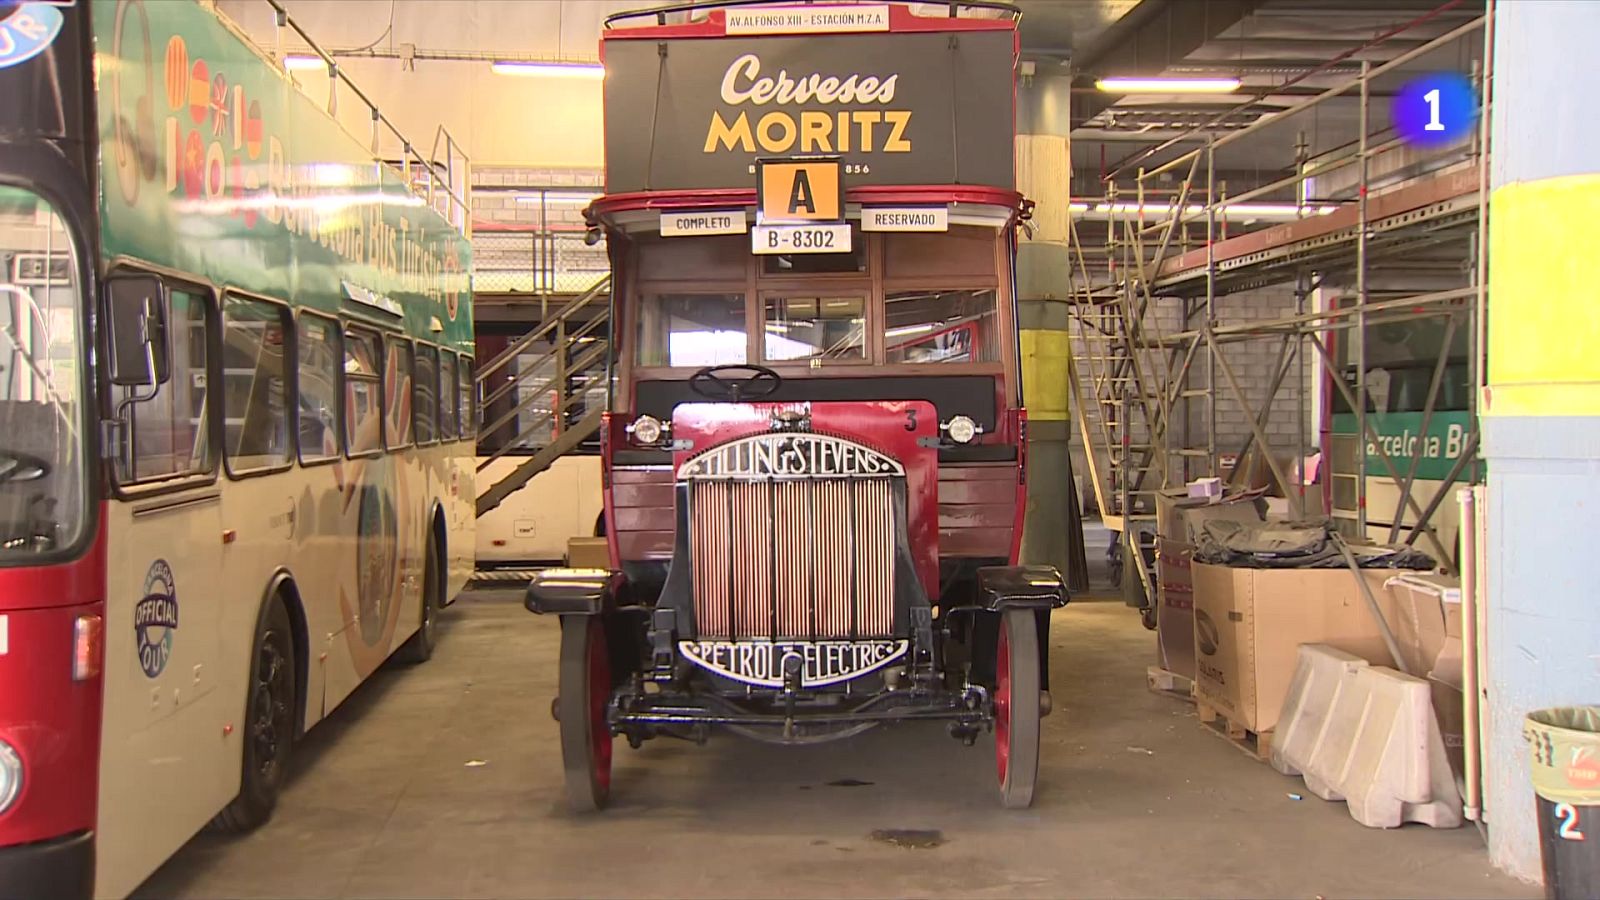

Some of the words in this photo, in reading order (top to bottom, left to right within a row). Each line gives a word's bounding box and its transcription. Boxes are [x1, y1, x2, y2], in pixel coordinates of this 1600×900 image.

[787, 14, 802, 25] XIII
[811, 11, 855, 25] ESTACIÓN
[857, 13, 884, 25] M.Z.A.
[721, 54, 899, 104] Cerveses
[704, 110, 912, 153] MORITZ
[845, 165, 870, 174] 856
[787, 169, 816, 214] A
[676, 217, 731, 230] COMPLETO
[875, 213, 935, 226] RESERVADO
[904, 409, 917, 431] 3
[136, 600, 176, 625] OFFICIAL
[139, 631, 169, 671] TOUR
[1554, 803, 1585, 840] 2
